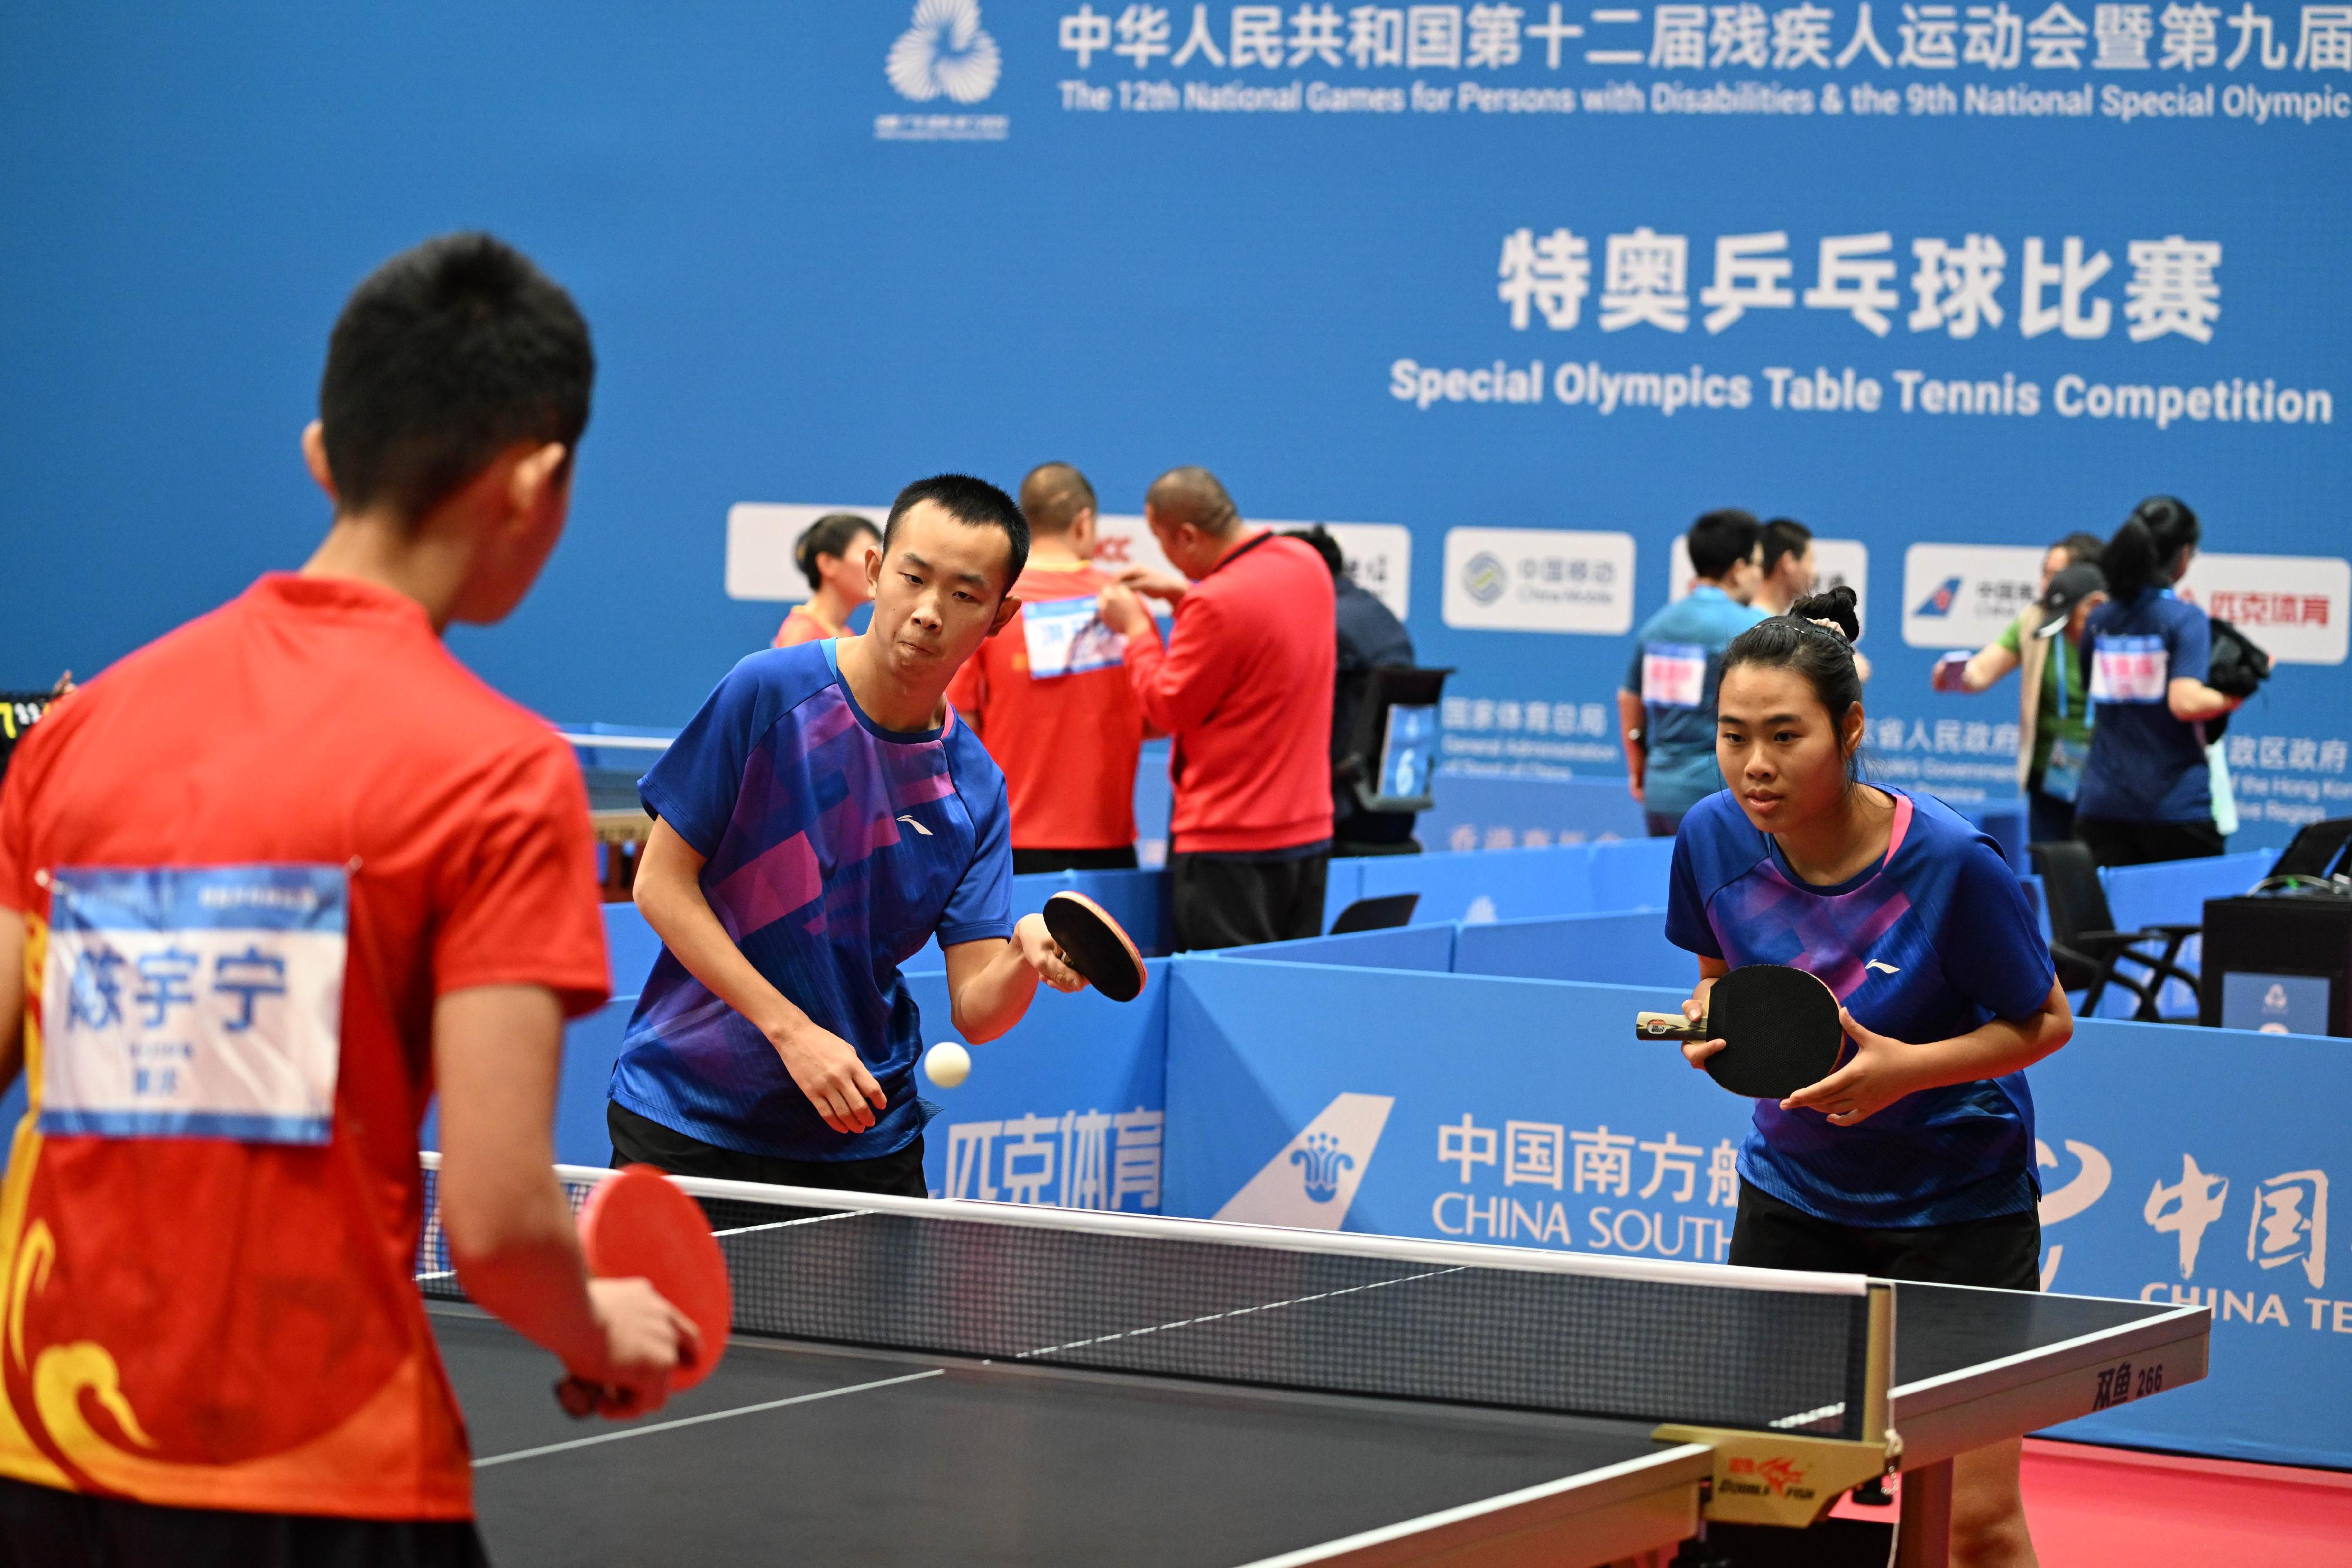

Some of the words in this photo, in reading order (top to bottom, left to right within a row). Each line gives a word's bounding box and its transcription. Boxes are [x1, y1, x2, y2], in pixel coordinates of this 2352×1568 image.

[1059, 2, 2352, 70] 中华人民共和国第十二届残疾人运动会暨第九届
[1059, 81, 1112, 111] The
[1118, 81, 1180, 111] 12th
[1184, 81, 1302, 112] National
[1306, 82, 1406, 112] Games
[1411, 81, 1453, 112] for
[1458, 82, 1576, 113] Persons
[1582, 81, 1645, 113] with
[1651, 82, 1815, 114] Disabilities
[1820, 83, 1844, 115] &
[1850, 83, 1900, 115] the
[1906, 83, 1957, 115] 9th
[1964, 83, 2093, 116] National
[2101, 84, 2215, 122] Special
[2223, 84, 2351, 124] Olympic
[1498, 227, 2222, 343] 特奥乒乓球比赛
[1389, 359, 1544, 410] Special
[1554, 360, 1752, 416] Olympics
[1763, 366, 1882, 412] Table
[1893, 369, 2040, 416] Tennis
[2054, 374, 2333, 430] Competition
[945, 1106, 1163, 1208] 匹克体育
[1432, 1192, 1572, 1245] CHINA
[2136, 1363, 2163, 1396] 266
